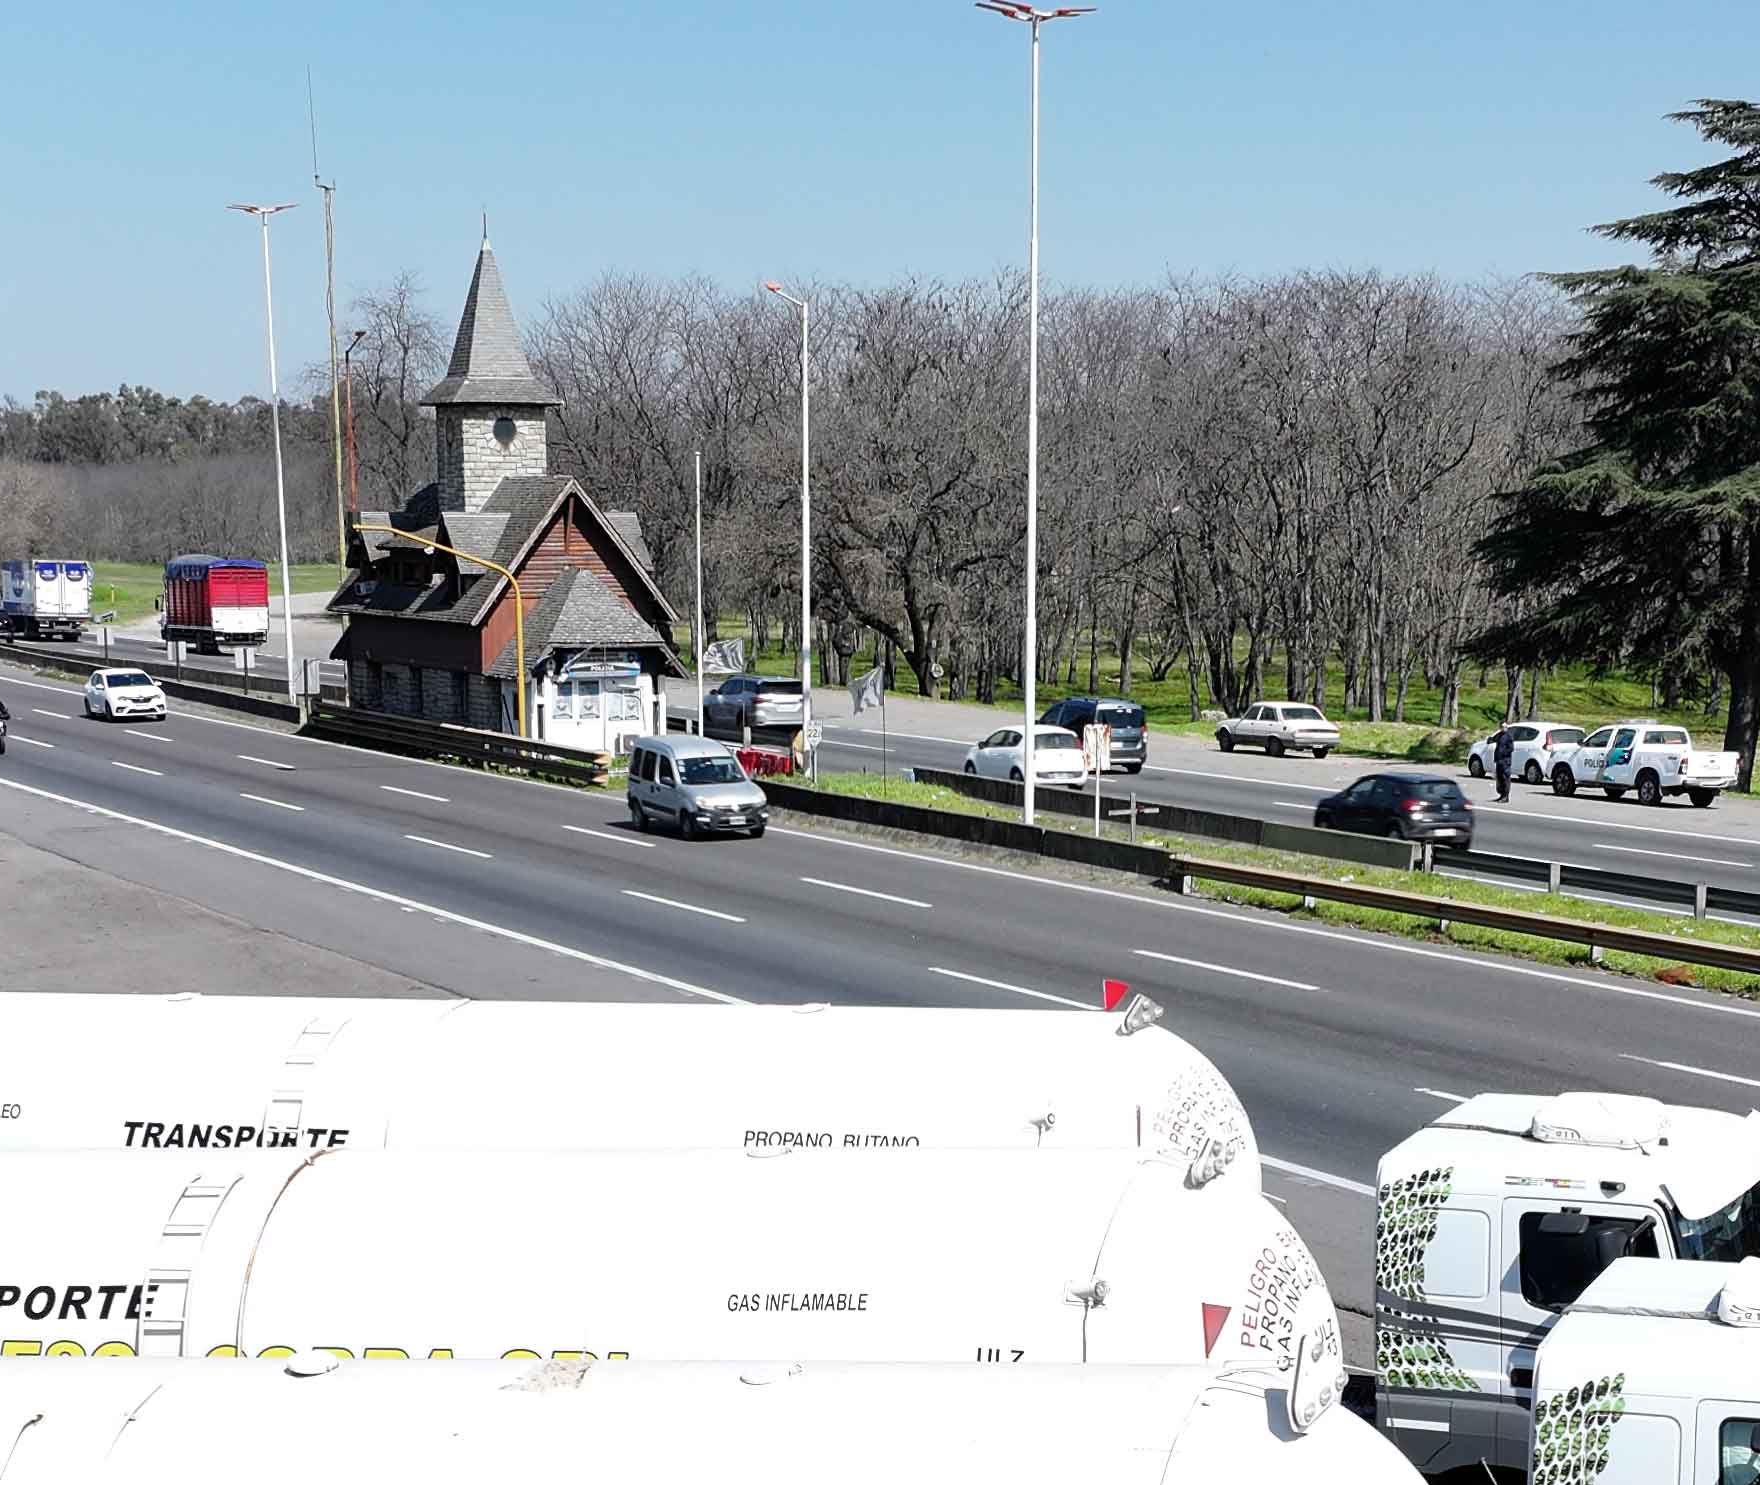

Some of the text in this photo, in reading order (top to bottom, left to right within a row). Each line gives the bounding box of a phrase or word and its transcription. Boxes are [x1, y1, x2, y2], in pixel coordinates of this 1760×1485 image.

[727, 1293, 869, 1312] GAS INFLAMABLE
[1240, 1248, 1277, 1348] PELIGRO
